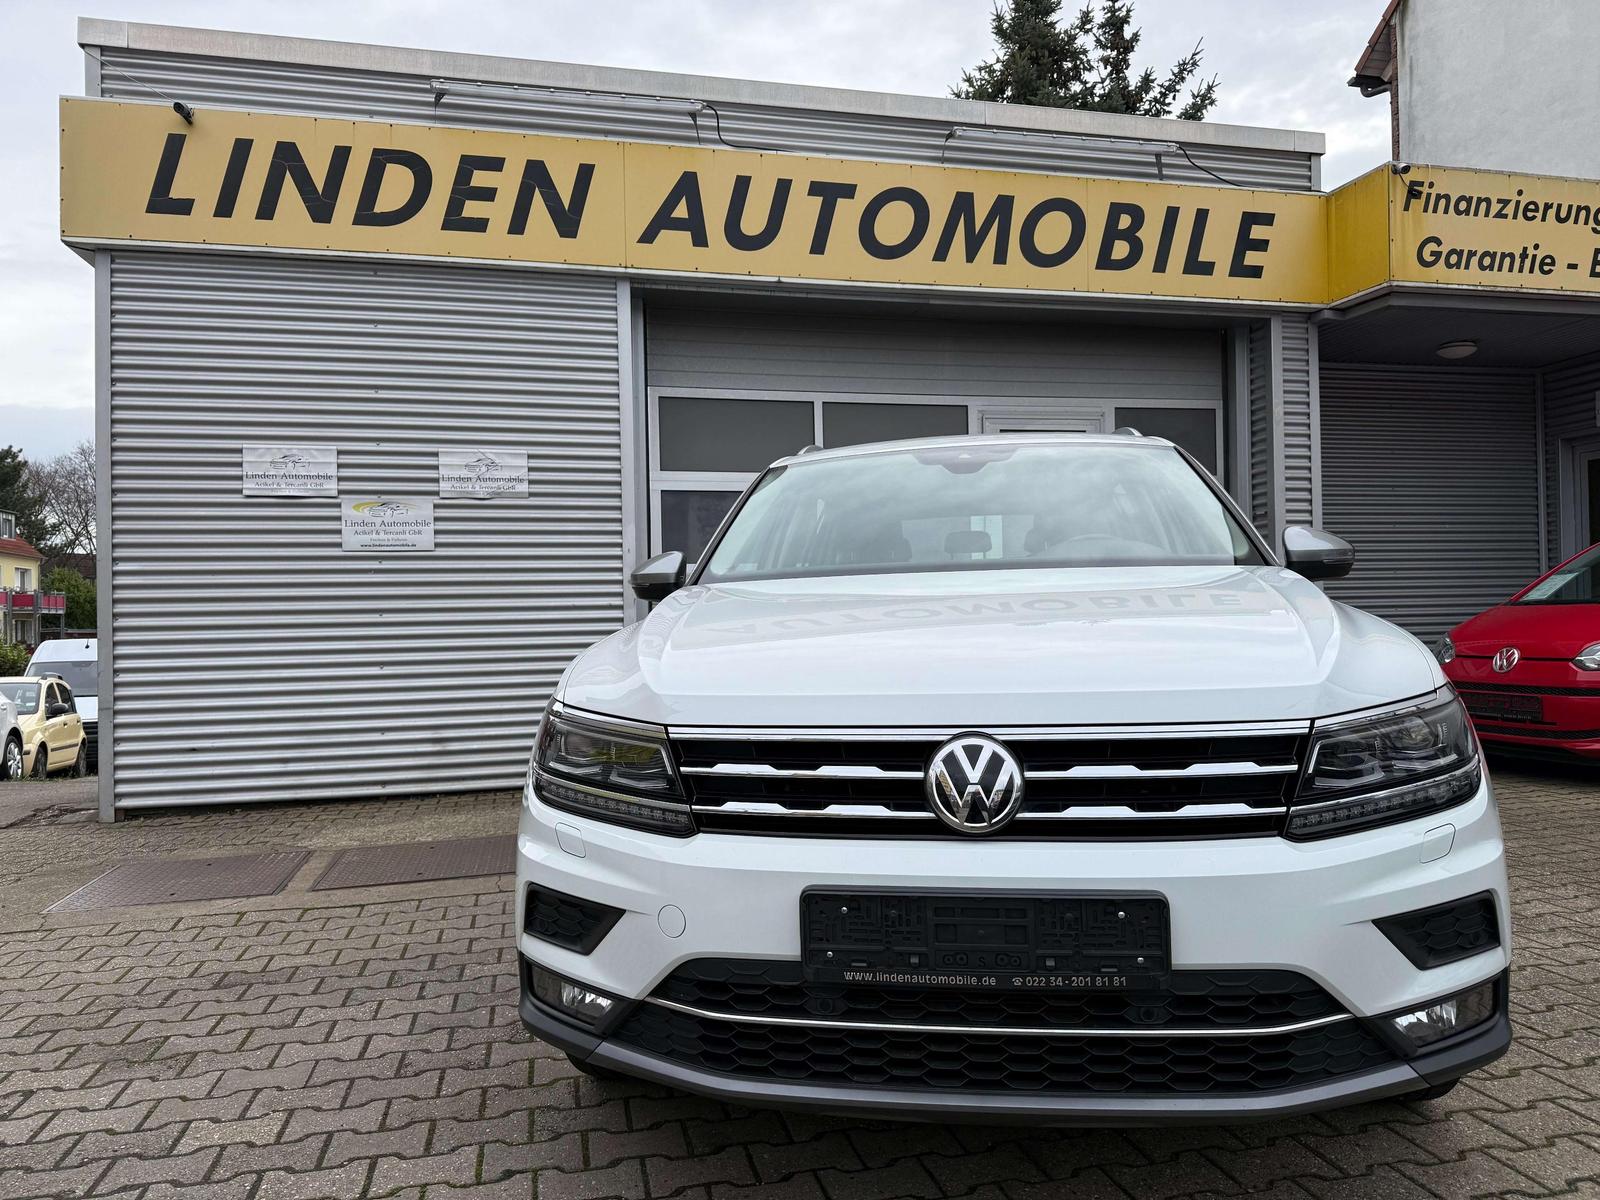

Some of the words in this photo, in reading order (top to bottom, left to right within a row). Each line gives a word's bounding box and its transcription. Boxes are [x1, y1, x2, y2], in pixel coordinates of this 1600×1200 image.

[145, 132, 596, 239] LINDEN
[637, 170, 1276, 279] AUTOMOBILE
[1416, 235, 1556, 276] Garantie
[245, 472, 277, 480] Linden
[280, 472, 334, 480] Automobile
[441, 474, 472, 482] Linden
[475, 475, 525, 483] Automobile
[344, 519, 376, 528] Linden
[379, 519, 432, 528] Automobile
[843, 971, 997, 986] www.lindenautomobile.de
[1025, 976, 1046, 987] 022
[1095, 976, 1109, 987] 81
[1113, 976, 1127, 987] 81
